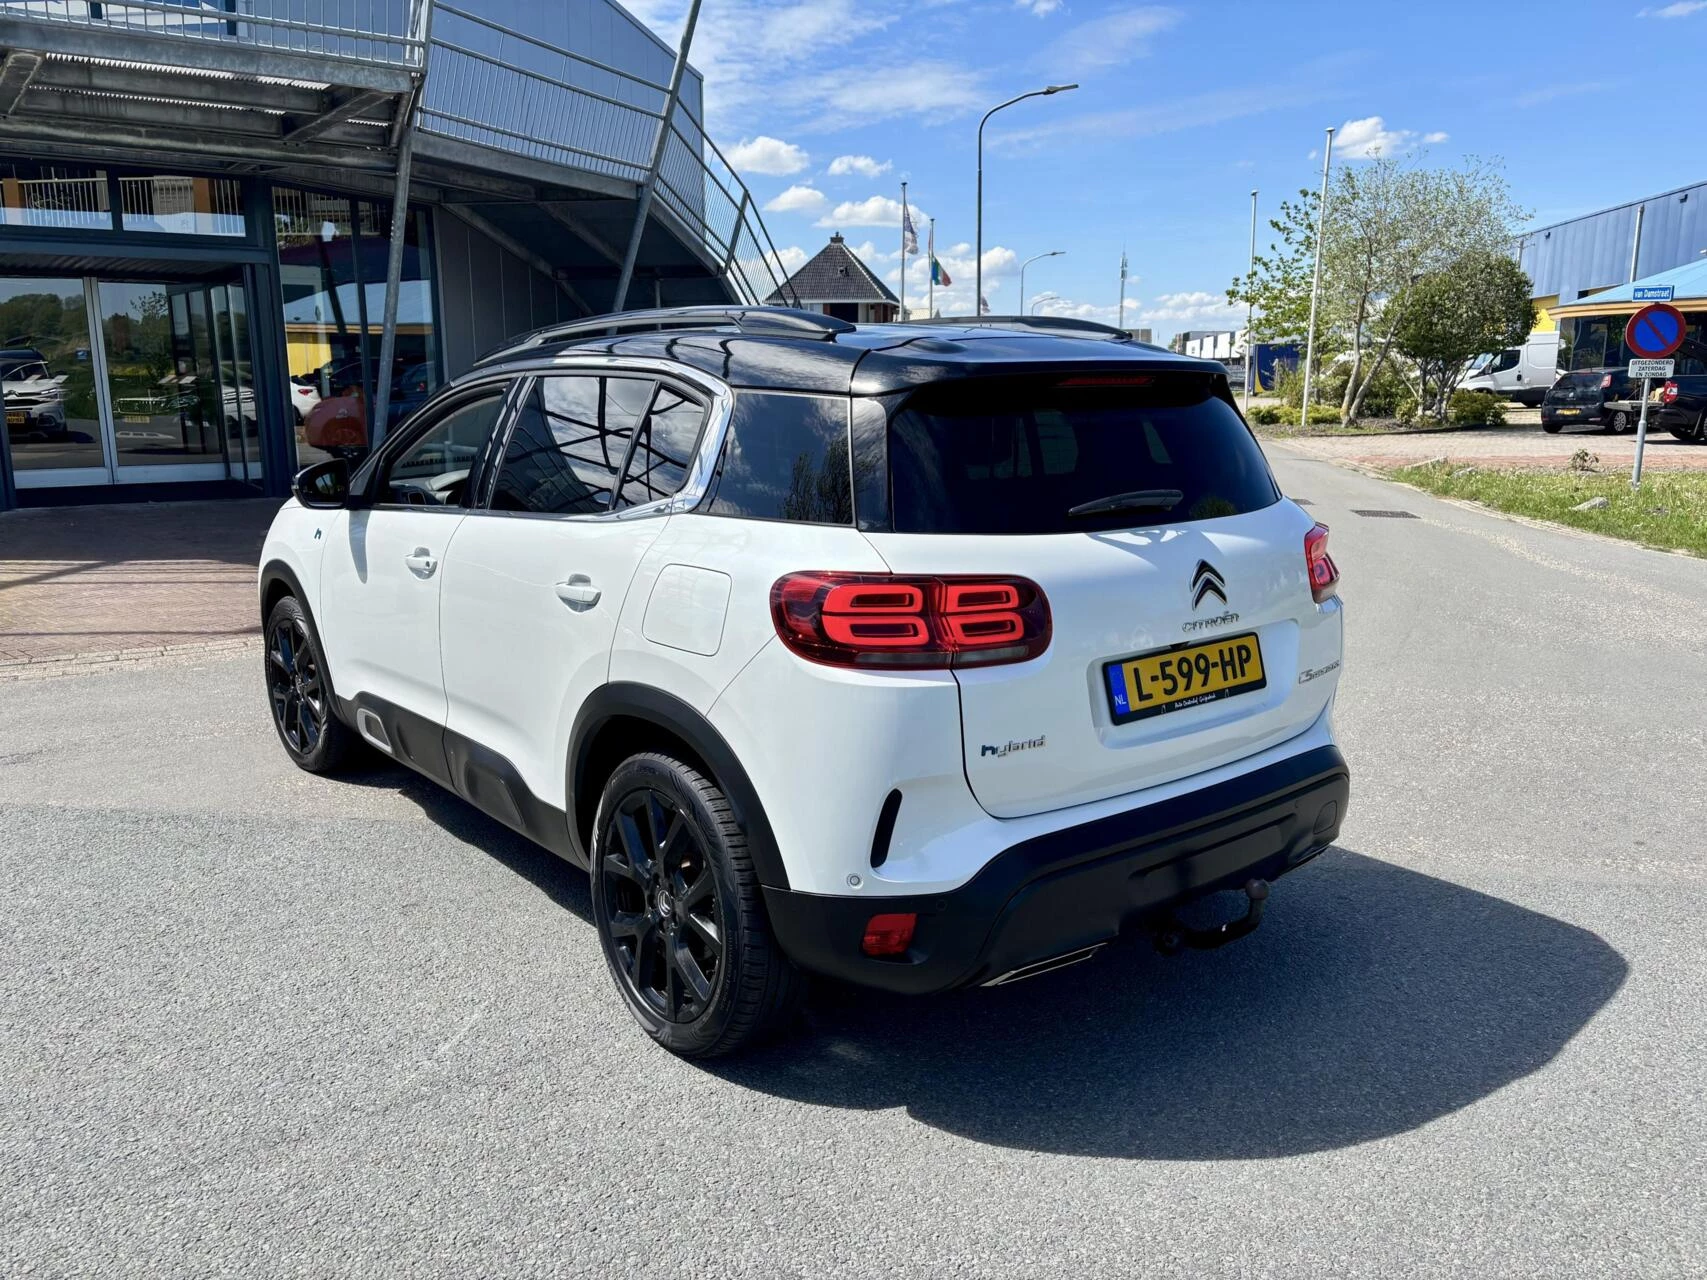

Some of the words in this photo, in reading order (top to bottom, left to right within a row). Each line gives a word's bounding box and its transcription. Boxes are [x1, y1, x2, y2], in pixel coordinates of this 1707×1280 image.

[1133, 644, 1252, 702] L-599-HP
[1114, 695, 1127, 706] NL
[981, 735, 1046, 758] hybrid
